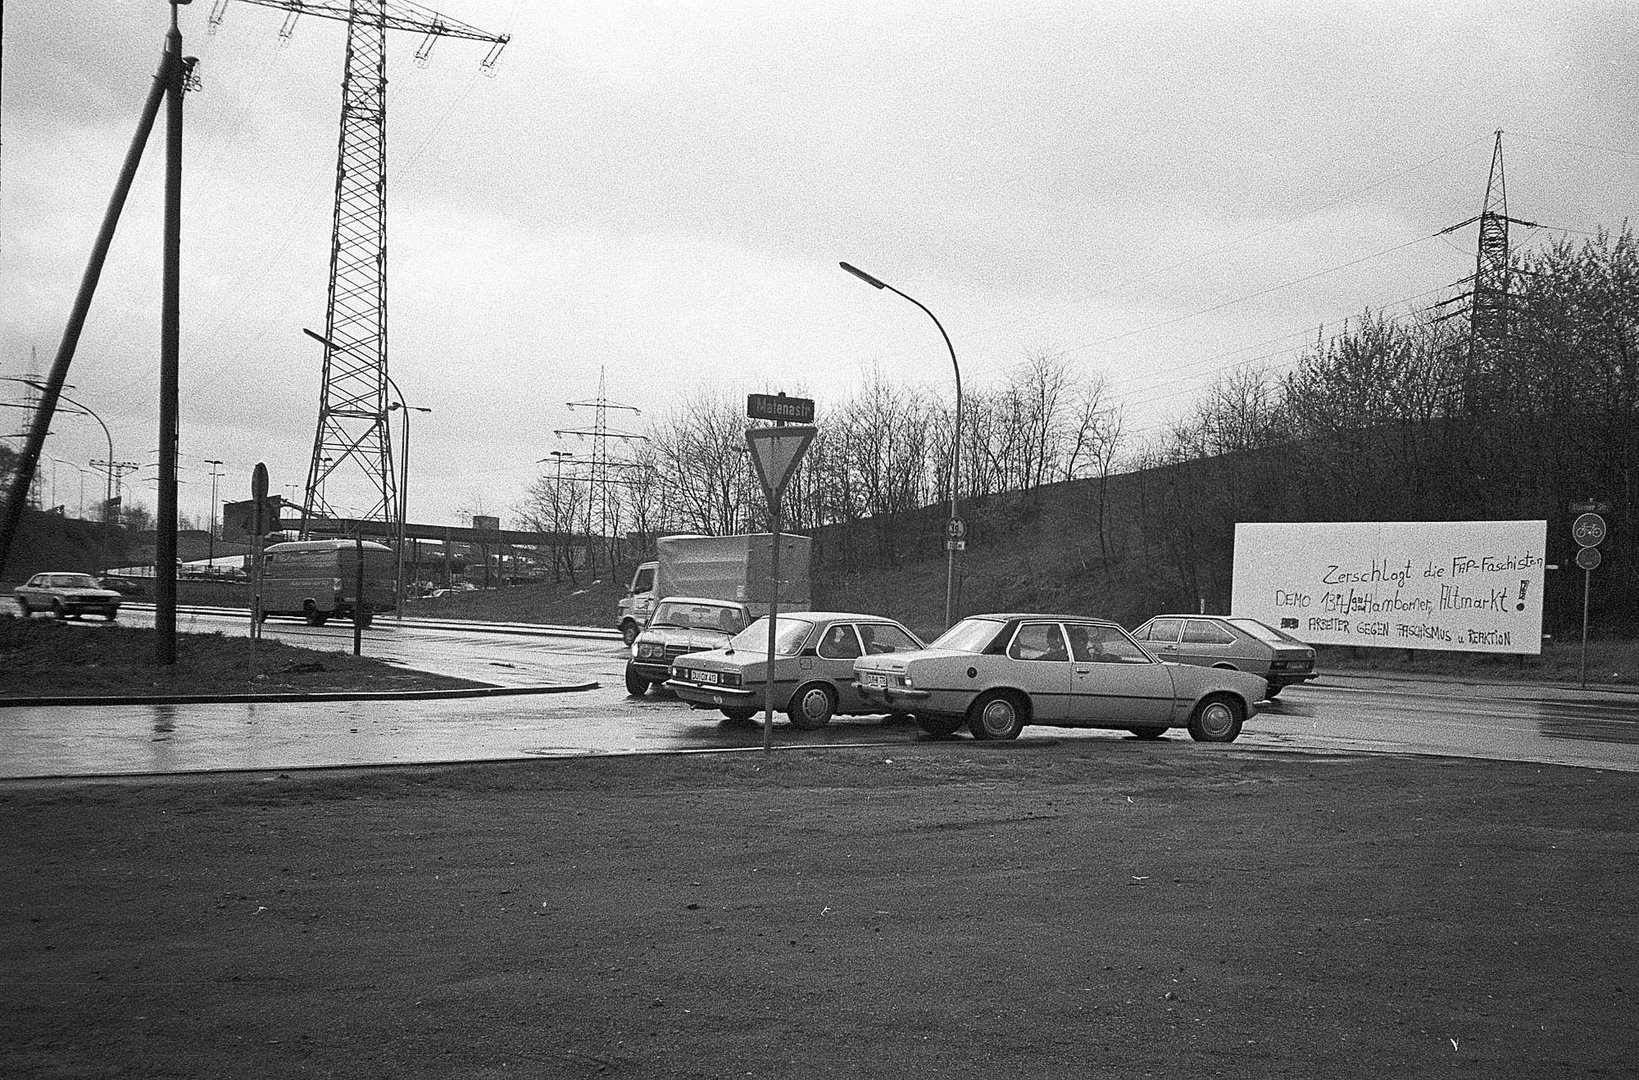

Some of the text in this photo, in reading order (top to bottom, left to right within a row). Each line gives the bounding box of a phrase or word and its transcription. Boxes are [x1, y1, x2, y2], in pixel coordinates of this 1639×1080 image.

[1423, 561, 1444, 578] die
[1276, 590, 1311, 608] DEMO
[1357, 622, 1389, 636] GEGEN
